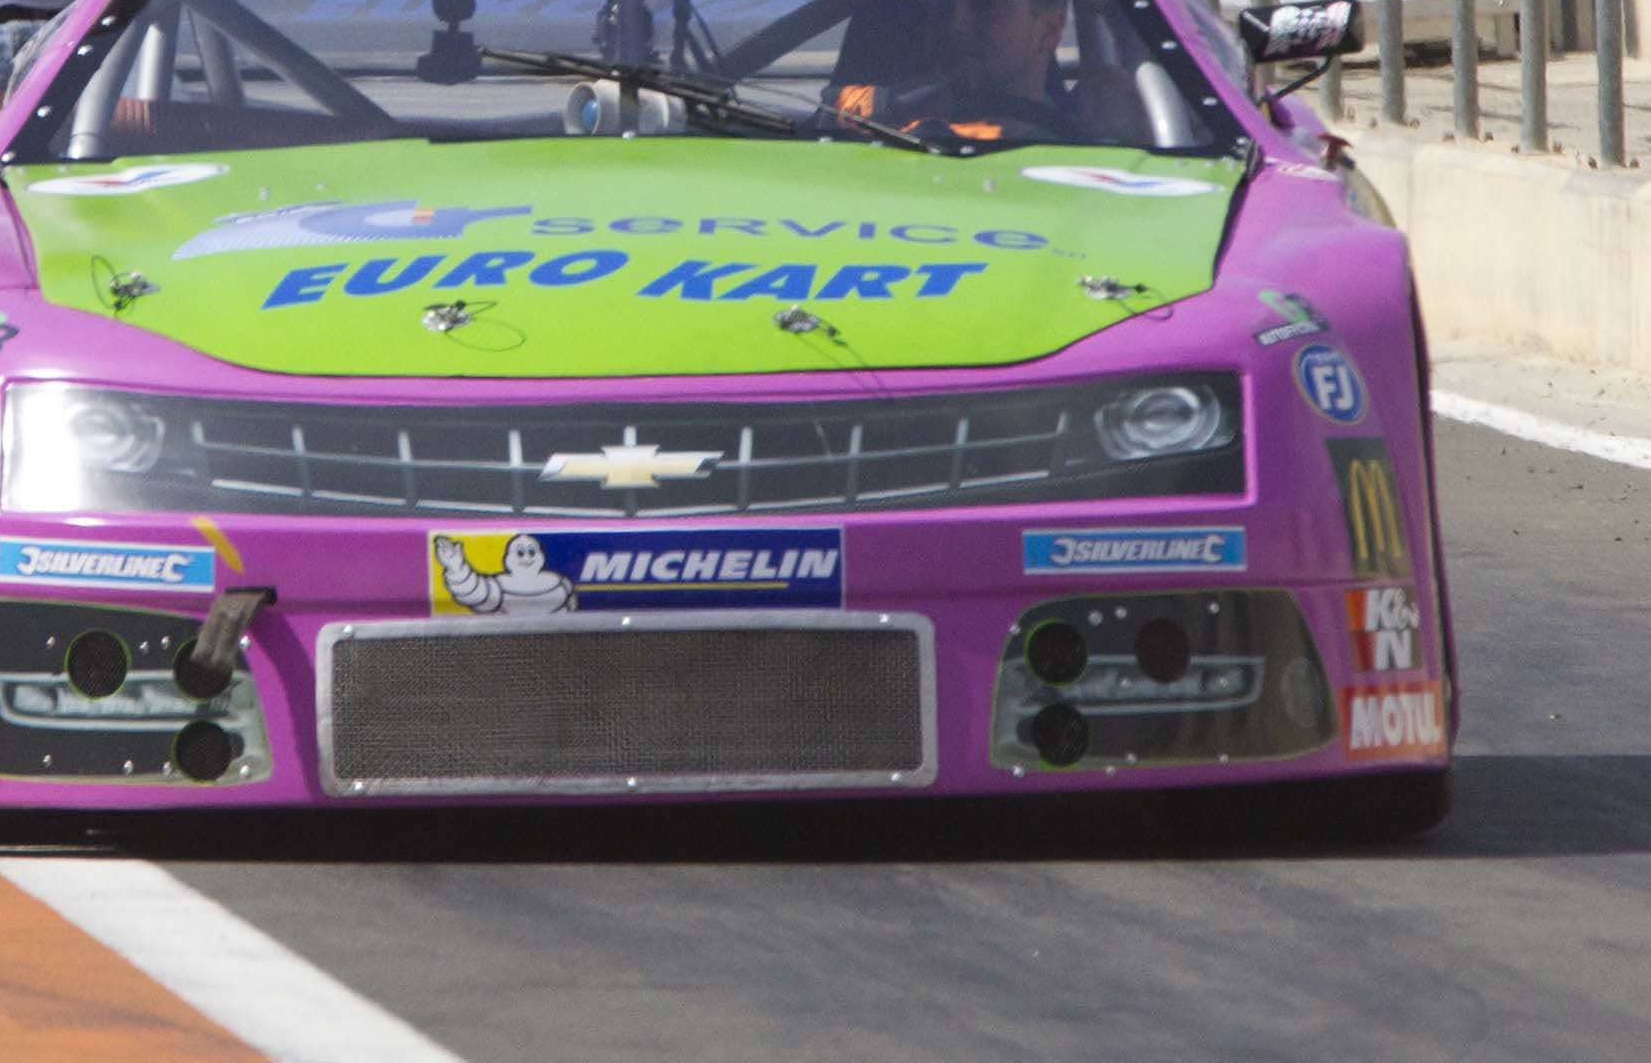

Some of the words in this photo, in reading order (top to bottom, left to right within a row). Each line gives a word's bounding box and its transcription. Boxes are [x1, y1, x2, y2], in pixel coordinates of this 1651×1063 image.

[259, 248, 630, 312] EURO
[635, 258, 991, 303] KART
[1311, 364, 1354, 410] FJ
[34, 548, 166, 580] SILVERLINE
[578, 548, 839, 583] MICHELIN
[1074, 536, 1208, 563] SILVERLINE
[1351, 692, 1442, 750] MOTUL
